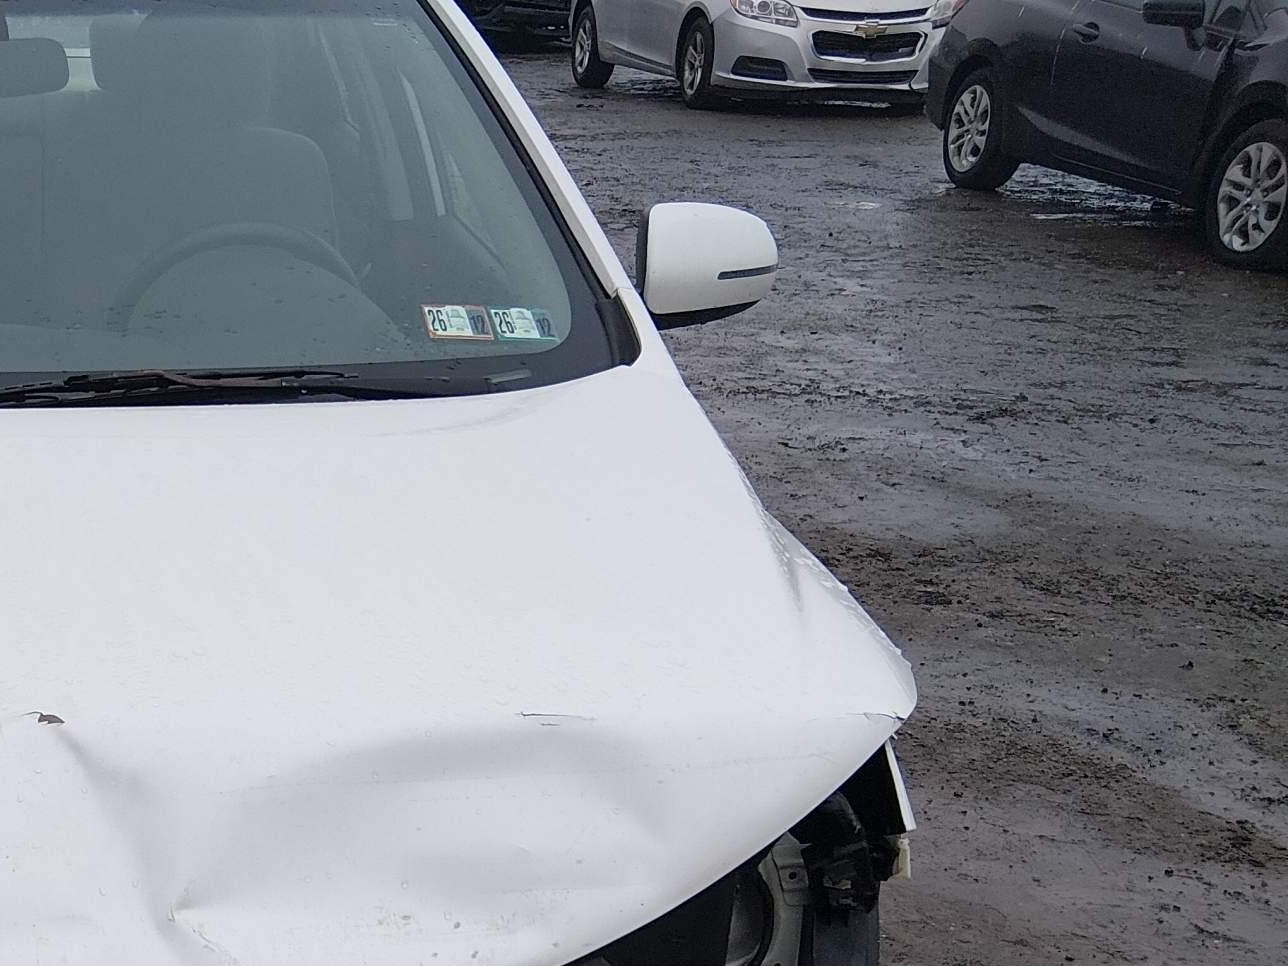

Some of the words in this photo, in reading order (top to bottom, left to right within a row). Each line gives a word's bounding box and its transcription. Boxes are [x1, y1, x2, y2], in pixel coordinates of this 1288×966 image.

[427, 309, 448, 332] 26
[470, 314, 489, 335] 12
[494, 311, 515, 334] 26
[535, 317, 556, 338] 12
